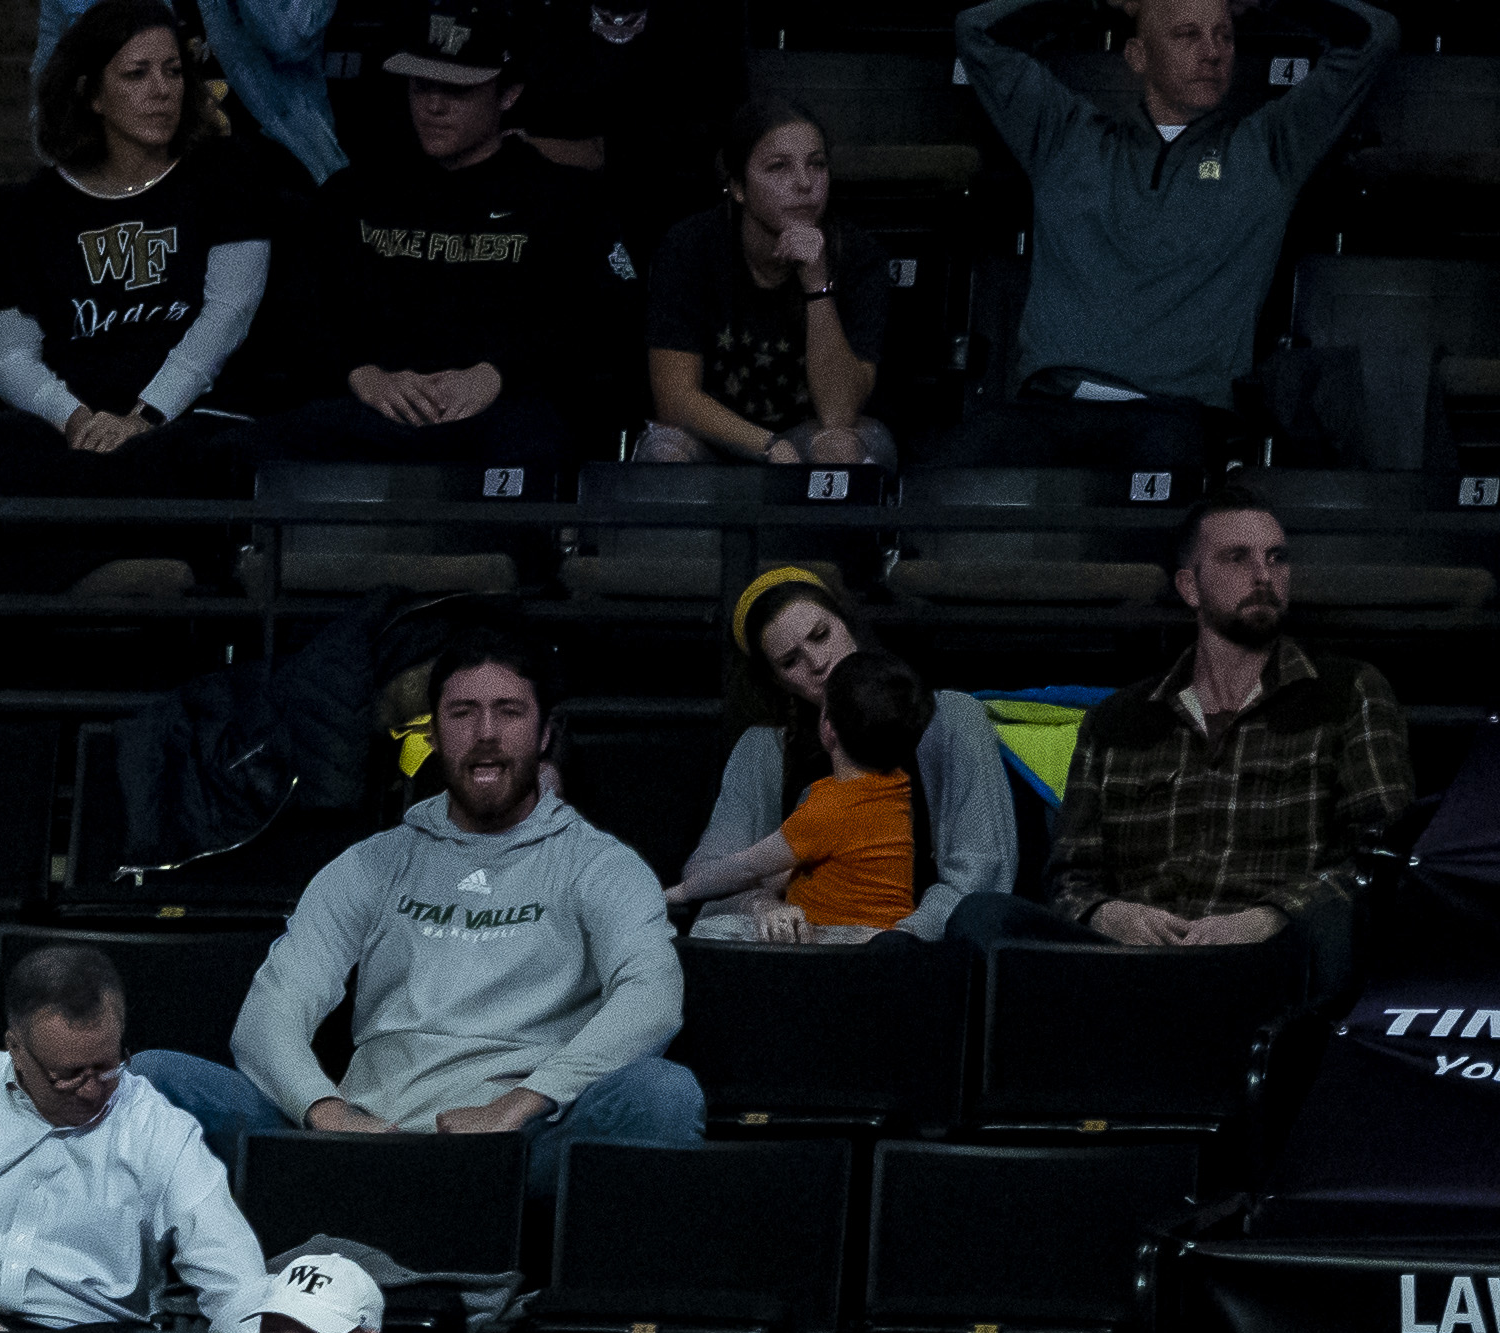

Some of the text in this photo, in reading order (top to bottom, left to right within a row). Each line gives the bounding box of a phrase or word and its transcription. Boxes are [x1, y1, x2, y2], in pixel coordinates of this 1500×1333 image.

[1282, 61, 1295, 84] 4
[77, 221, 177, 291] WF
[496, 471, 510, 495] 2
[821, 474, 834, 497] 3
[1142, 475, 1154, 499] 4
[1472, 480, 1485, 503] 5
[465, 902, 545, 930] VALLEY
[1434, 1055, 1500, 1083] Yo
[287, 1265, 333, 1294] WF
